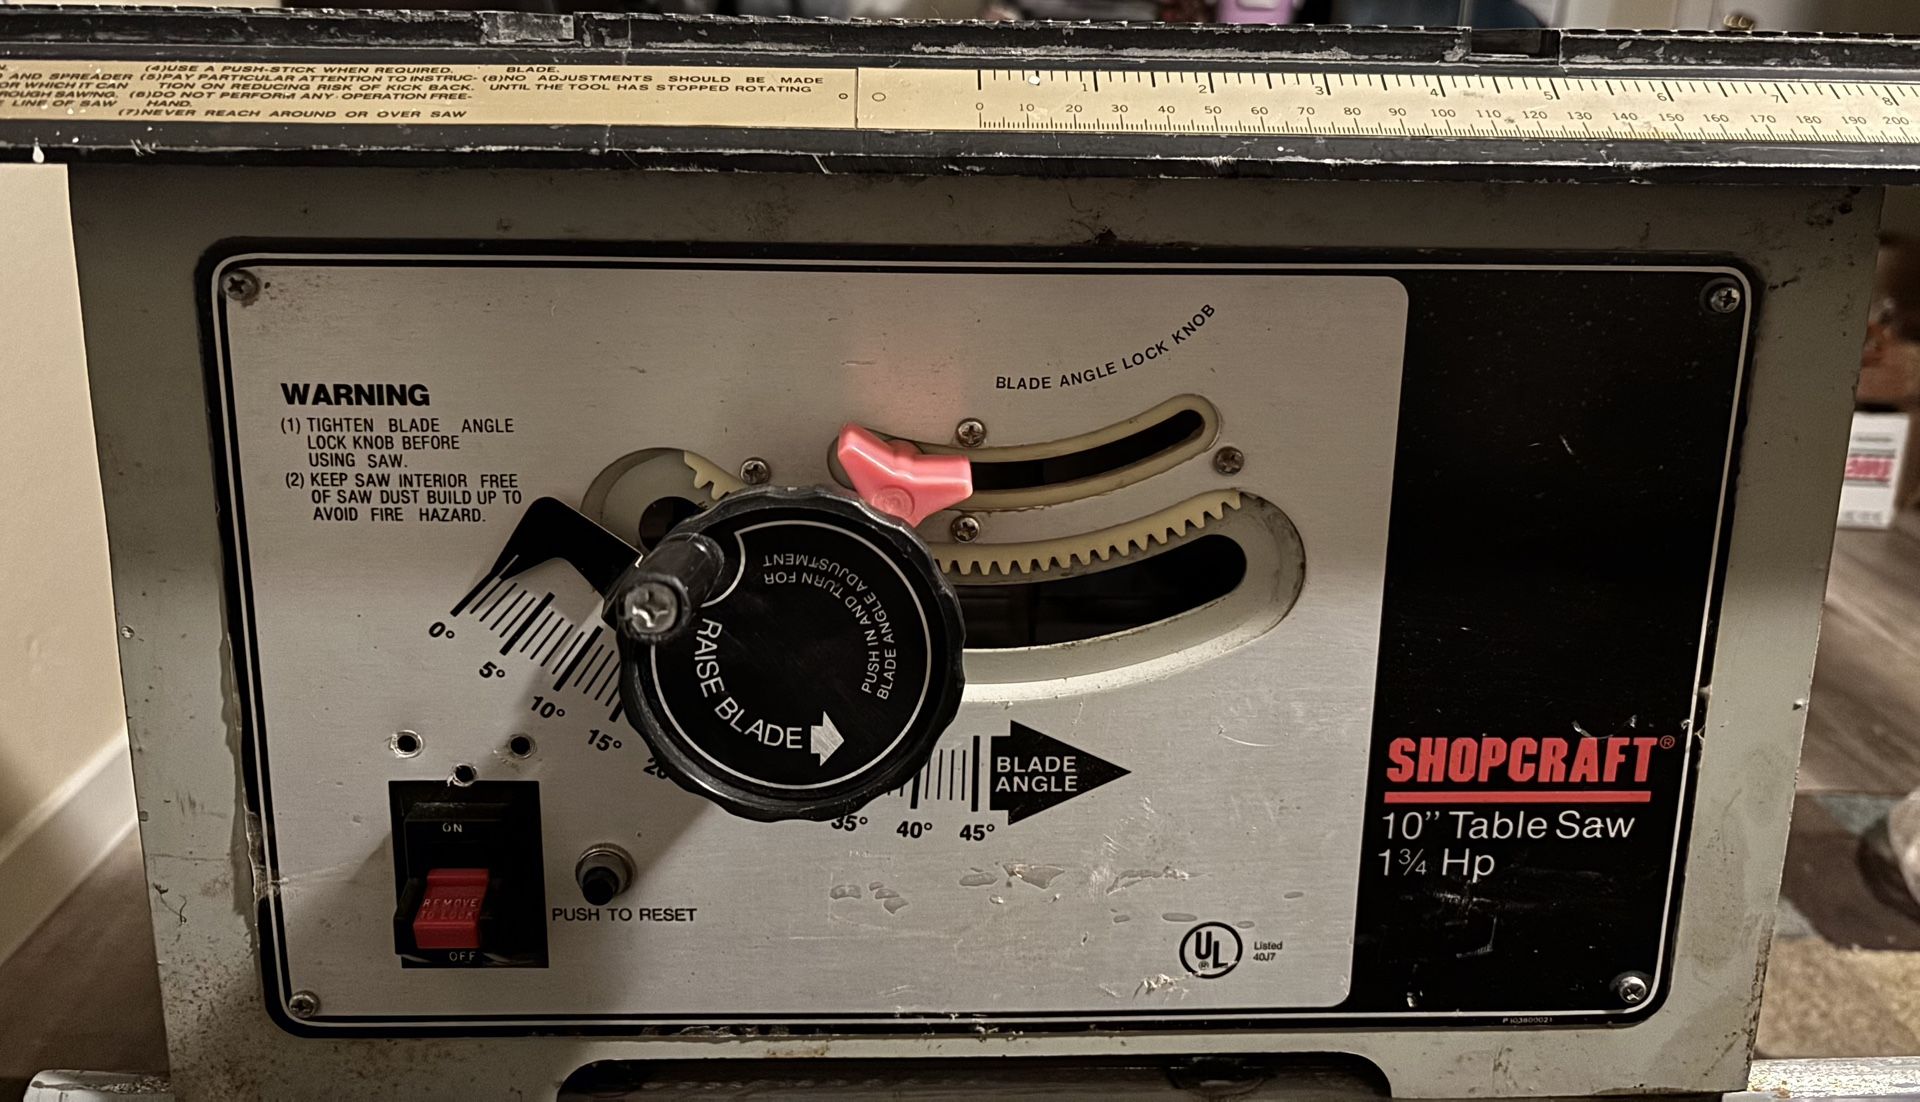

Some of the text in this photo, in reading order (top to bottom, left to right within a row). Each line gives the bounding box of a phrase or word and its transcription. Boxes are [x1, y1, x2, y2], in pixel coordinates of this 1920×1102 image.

[374, 66, 453, 74] REQUIRED.
[197, 74, 295, 82] PARTICULAR
[668, 75, 731, 83] SHOULD
[780, 76, 824, 84] MADE
[180, 91, 215, 99] NOT
[219, 92, 296, 100] PERFORM
[489, 83, 530, 91] UNTIL
[535, 83, 563, 91] THE
[735, 85, 812, 93] ROTATING
[1199, 85, 1207, 94] 2
[1315, 86, 1324, 95] 3
[1430, 89, 1439, 97] 4
[1544, 91, 1553, 100] 5
[1657, 93, 1667, 101] 6
[1771, 94, 1779, 103] 7
[1882, 96, 1893, 106] 8
[204, 109, 261, 117] REACH
[269, 110, 336, 118] AROUND
[345, 110, 368, 118] OR
[430, 110, 467, 118] SAW
[976, 102, 1910, 125] 0 10 20 30 40 50 60 70 80 90 100 110 120 130 140 150 160 170 180 190 200
[995, 304, 1215, 390] BLADE ANGLE LOCK KNOB
[280, 383, 430, 406] WARNING
[280, 417, 514, 434] (1) TIGHTEN BLADE ANGLE
[307, 435, 460, 450] LOCK KNOB BEFORE
[309, 452, 408, 468] USING SAW.
[285, 472, 518, 489] (2) KEEP SAW INTERIOR FREE
[311, 490, 522, 505] OF SAW DUST BUILD UP TO
[313, 507, 486, 522] AVOID FIRE HAZARD.
[763, 553, 896, 700] BLADE ANGLE ADJUSTMENT
[764, 571, 880, 693] PUSH IN AND TURN FOR
[694, 618, 803, 749] RAISE BLADE
[996, 756, 1077, 773] BLADE
[995, 775, 1078, 792] ANGLE
[442, 823, 463, 833] ON
[1449, 810, 1548, 839] Table
[1555, 809, 1635, 839] Saw
[1442, 848, 1495, 883] Hp
[422, 898, 479, 908] REMOVE
[552, 909, 697, 921] PUSH TO RESET
[1195, 931, 1228, 968] UL
[1254, 940, 1283, 950] Listed
[449, 952, 476, 961] OFF
[1253, 952, 1276, 961] 40J7
